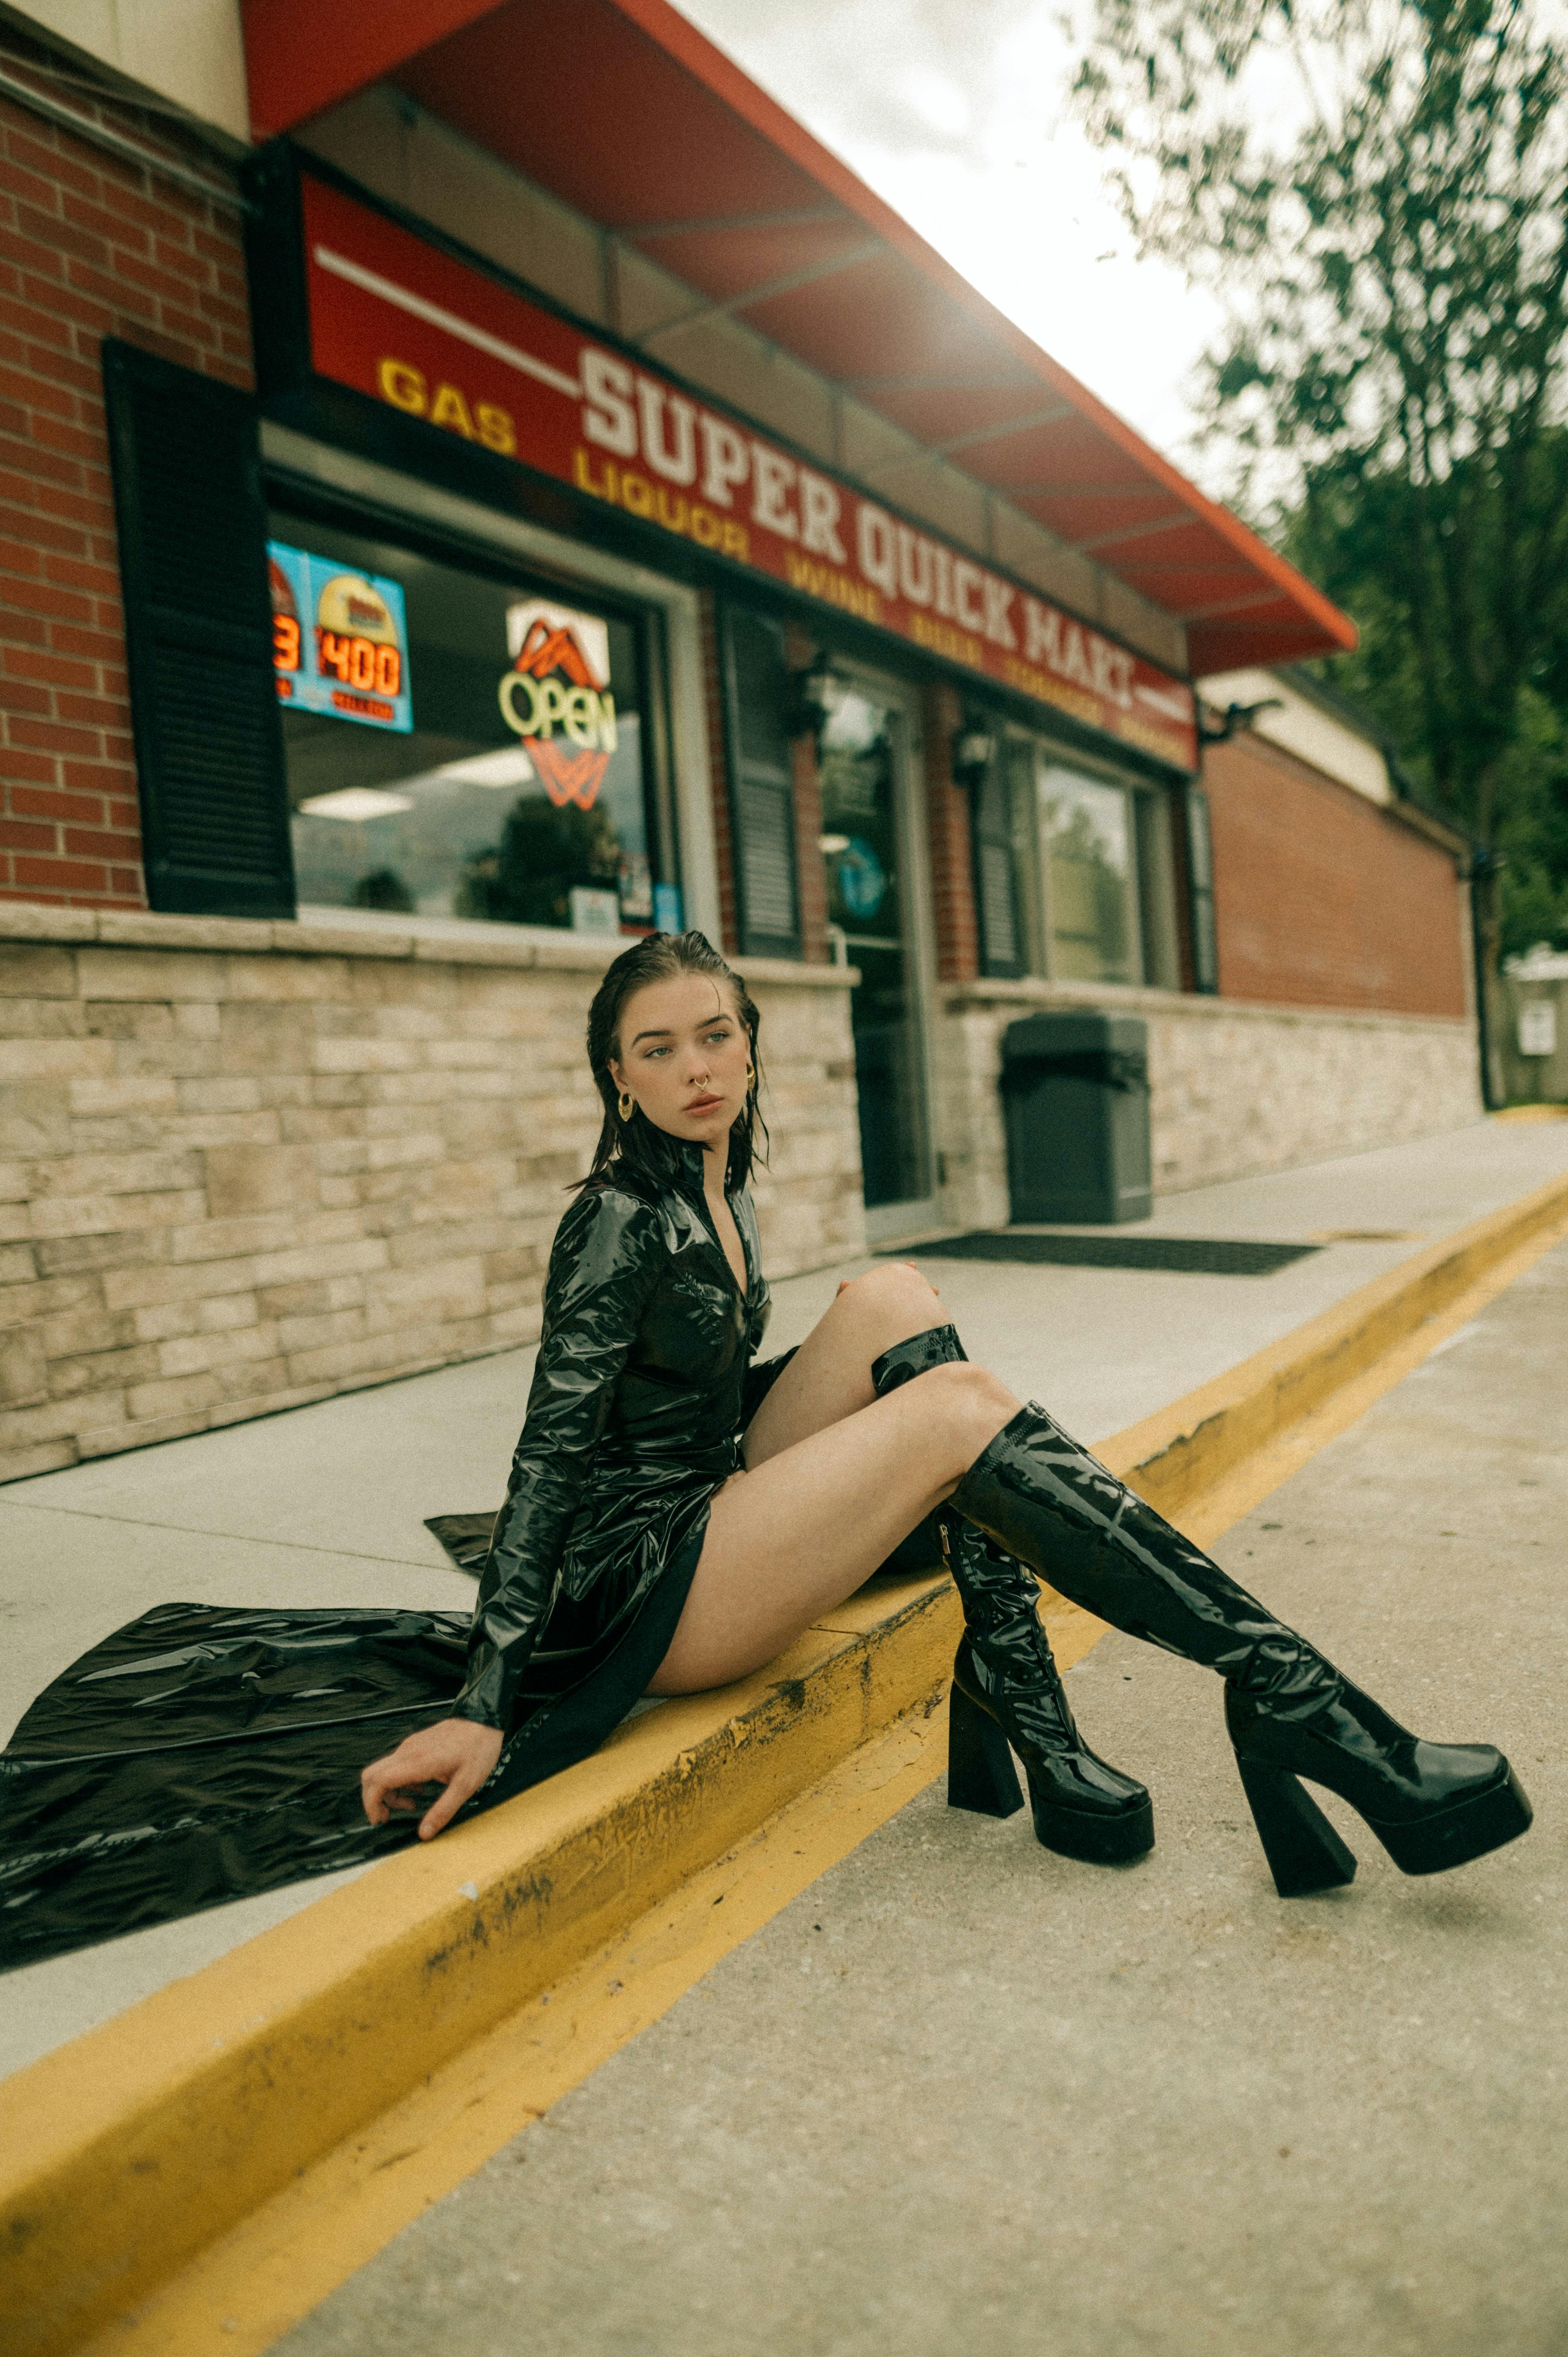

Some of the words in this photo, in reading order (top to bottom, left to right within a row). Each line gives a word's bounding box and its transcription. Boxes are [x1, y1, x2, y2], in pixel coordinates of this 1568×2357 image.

[376, 355, 517, 457] GAS
[574, 446, 750, 565] LIQUOR
[579, 348, 847, 566] SUPER
[859, 501, 1016, 650] QUICK
[1022, 593, 1135, 709] MART
[321, 631, 400, 698] 400
